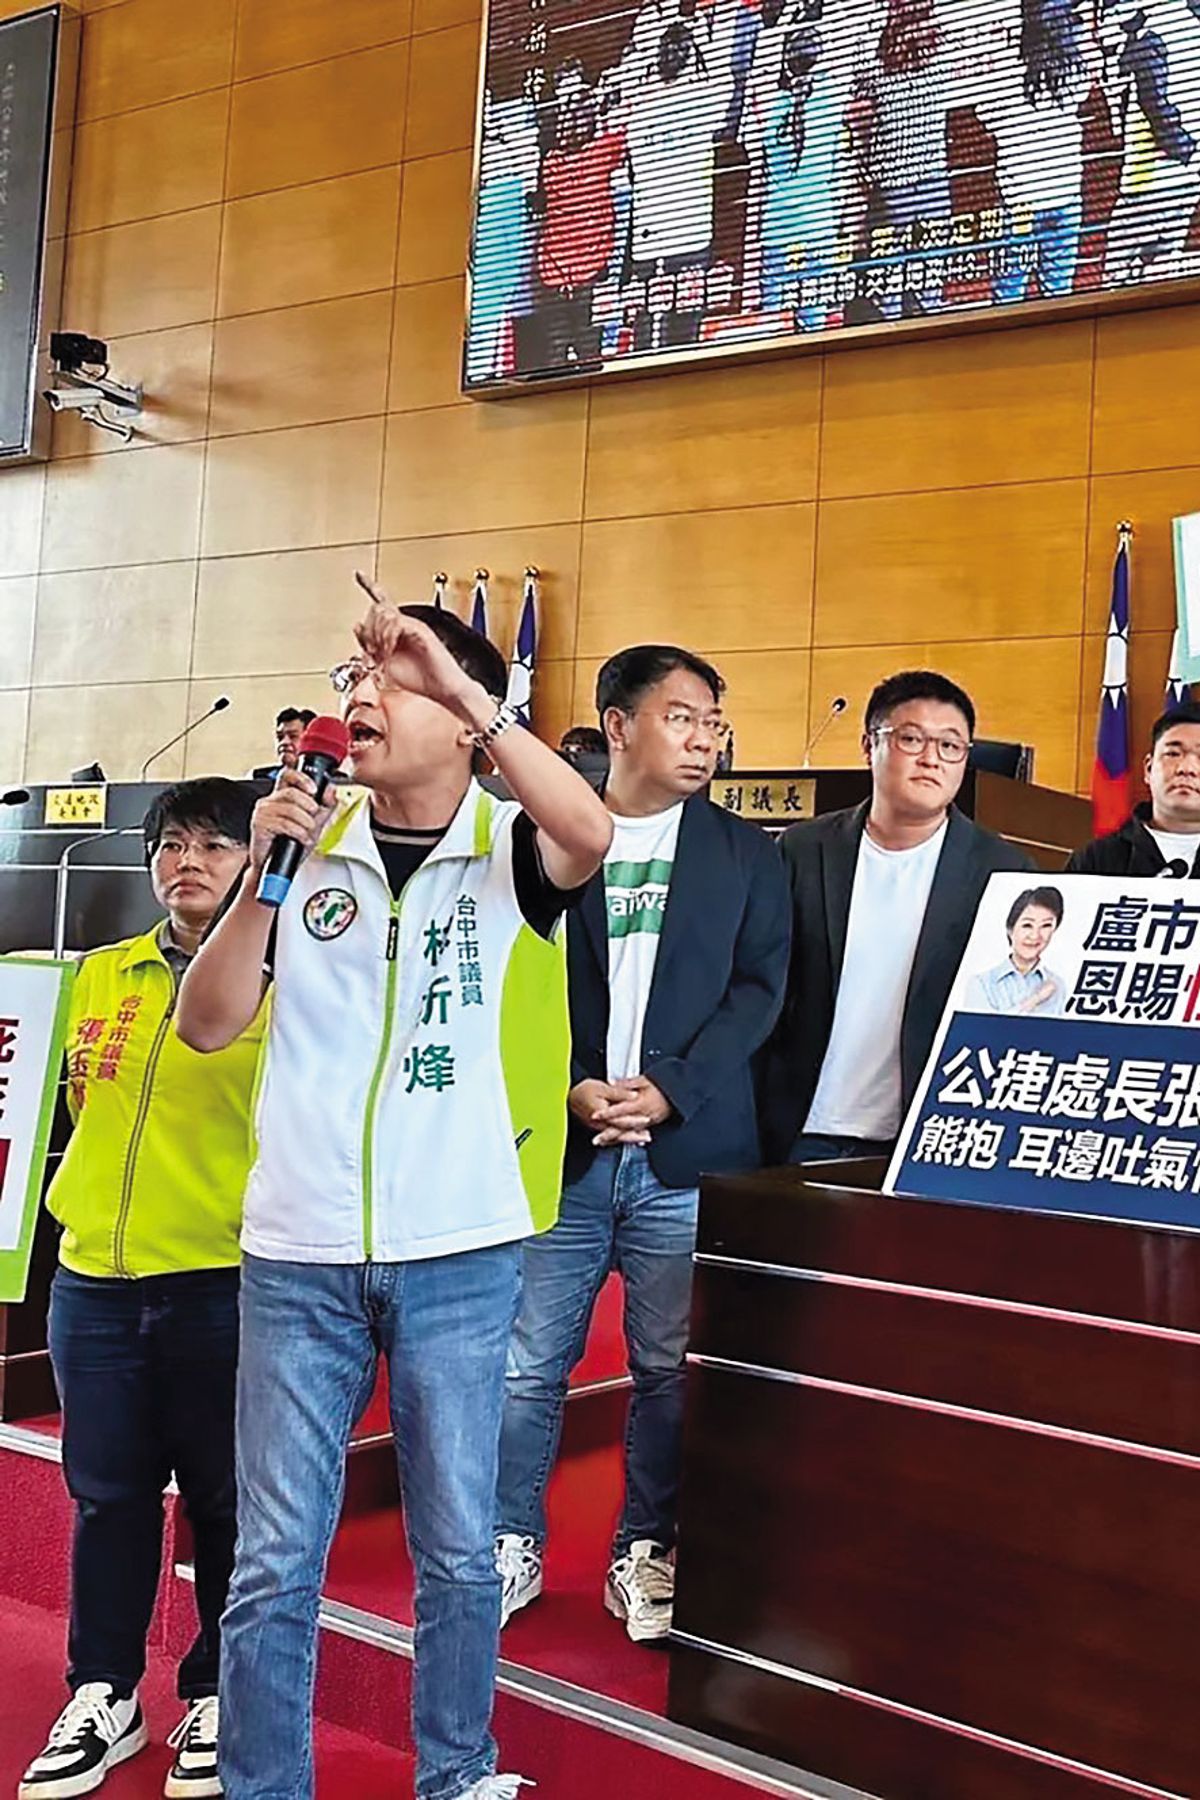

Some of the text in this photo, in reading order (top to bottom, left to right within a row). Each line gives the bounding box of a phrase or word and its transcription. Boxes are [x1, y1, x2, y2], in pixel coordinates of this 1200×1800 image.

[724, 785, 802, 813] 副議長
[456, 894, 484, 1007] 台中市議員
[910, 1113, 1005, 1170] 熊抱
